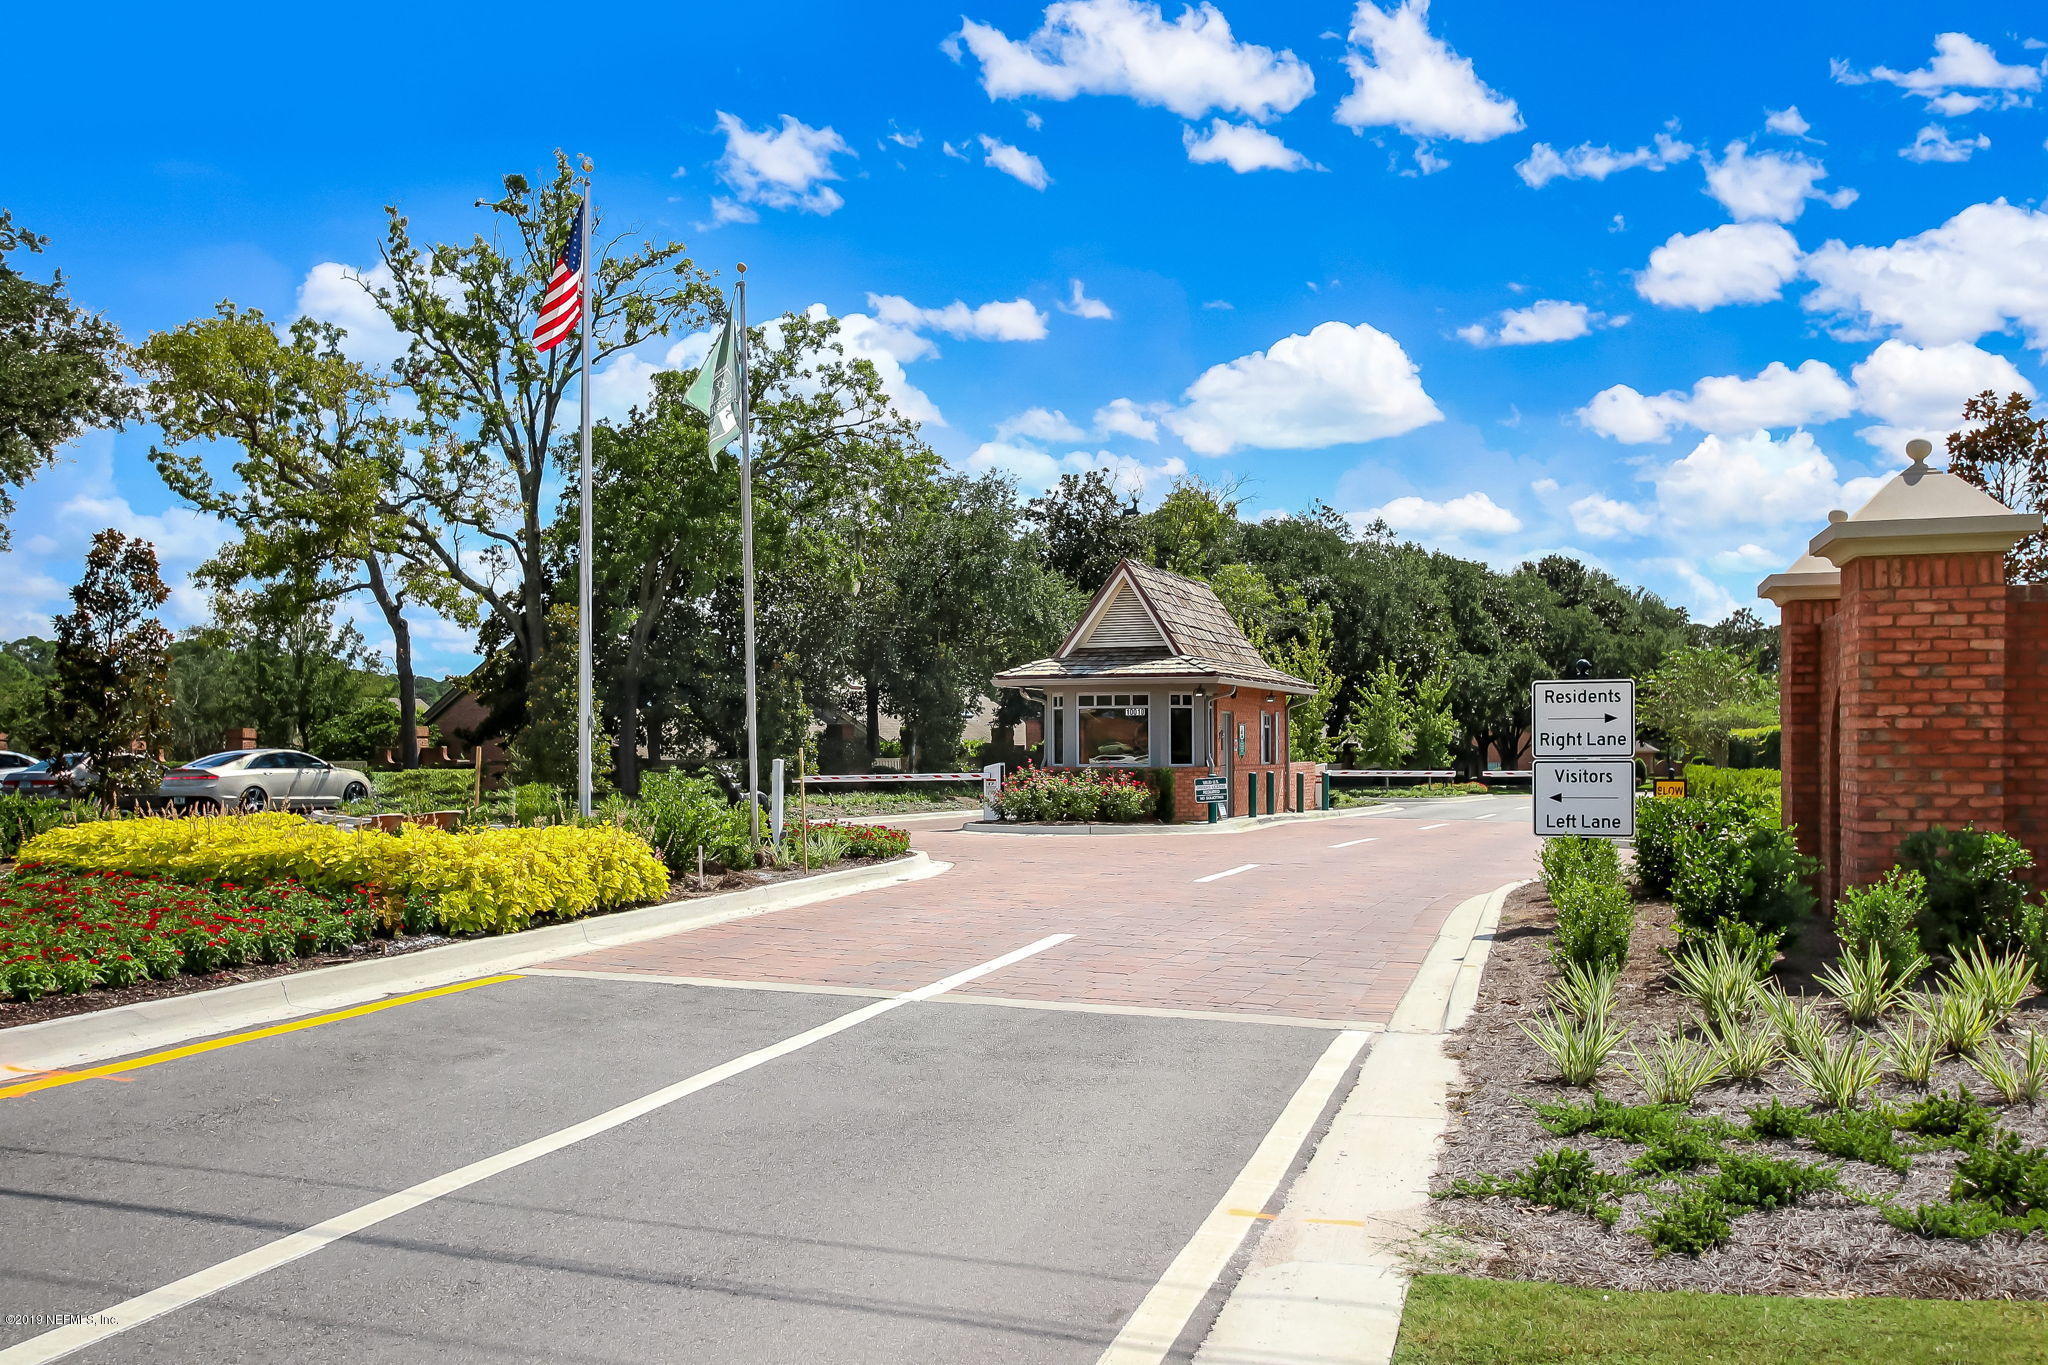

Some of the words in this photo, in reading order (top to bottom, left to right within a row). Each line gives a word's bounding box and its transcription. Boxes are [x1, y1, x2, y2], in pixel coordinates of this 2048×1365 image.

[1544, 689, 1621, 704] Residents
[1540, 732, 1582, 750] Right
[1587, 732, 1627, 746] Lane
[1554, 769, 1613, 783] Visitors
[1657, 786, 1683, 796] SLOW
[1546, 814, 1577, 829] Left
[1581, 814, 1621, 829] Lane
